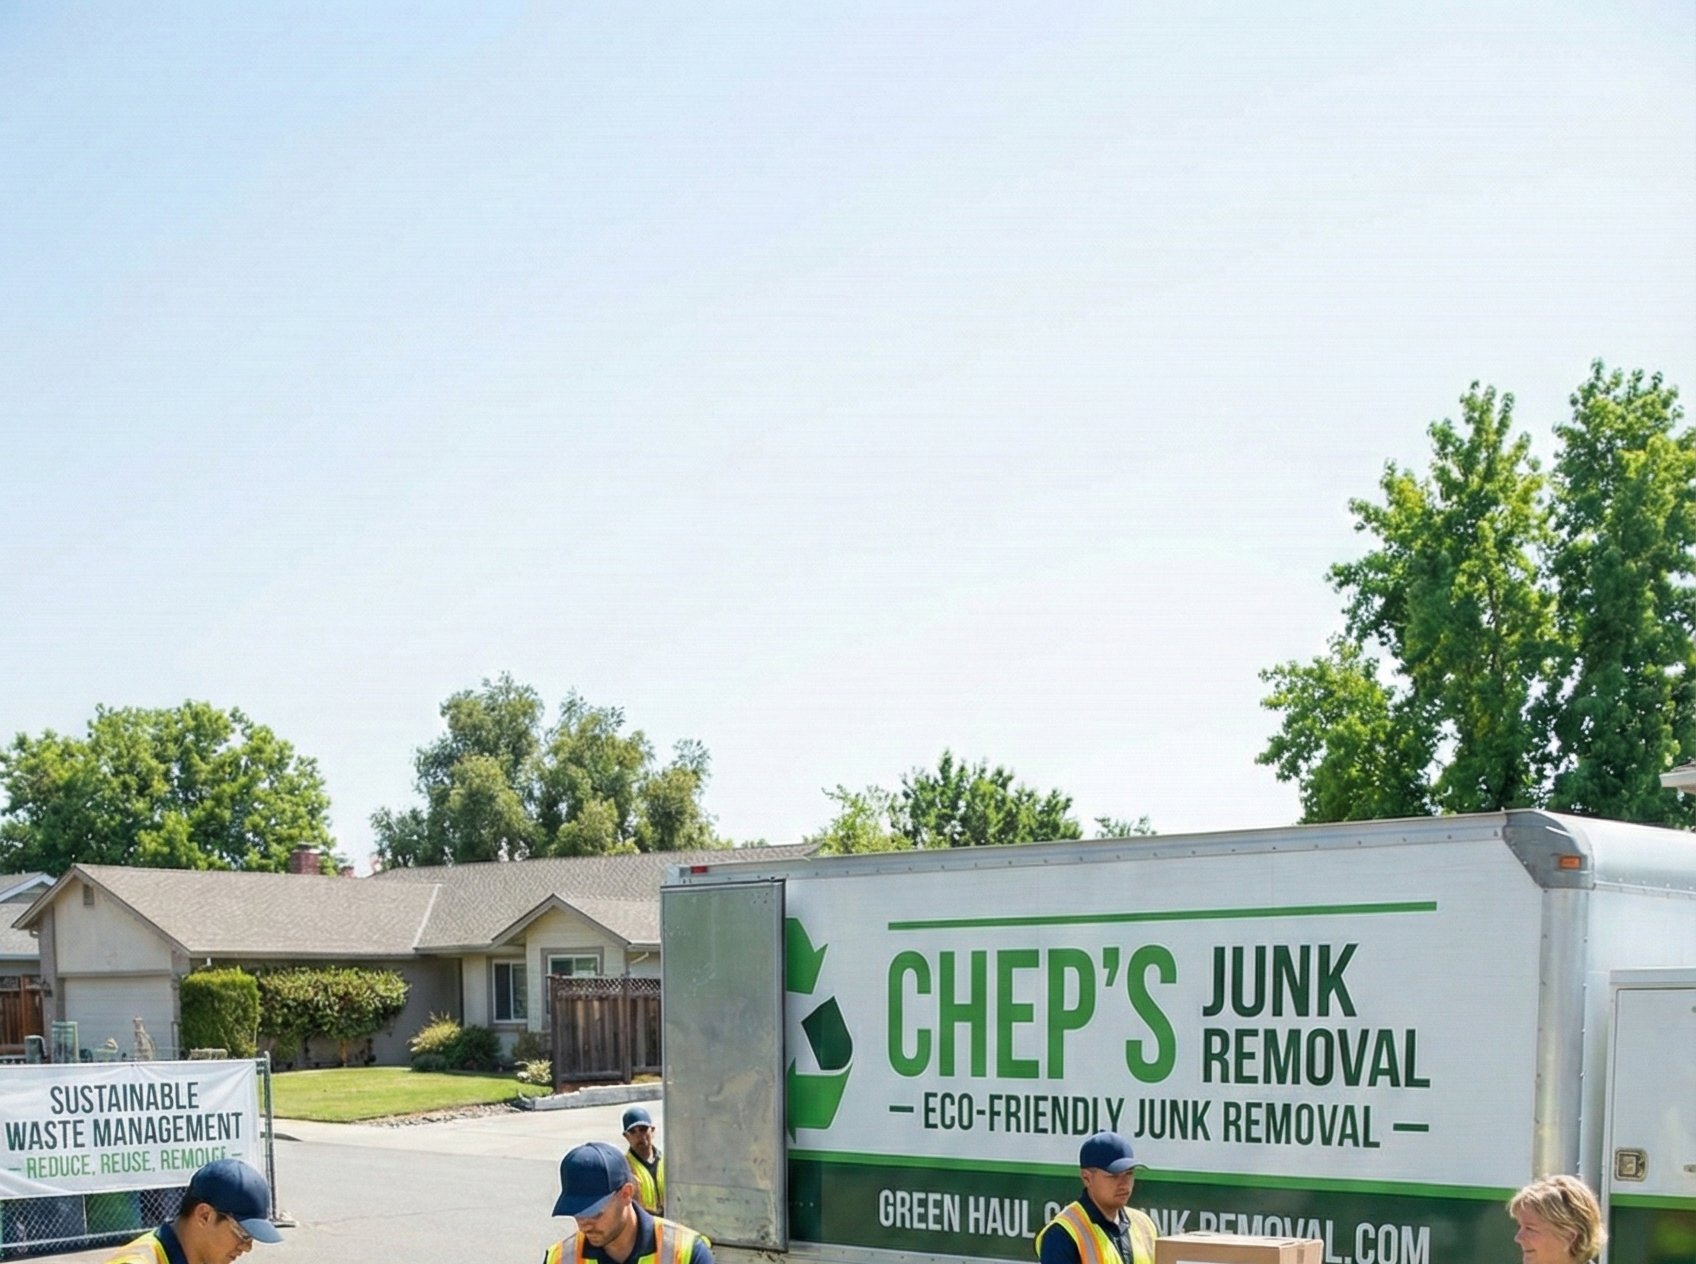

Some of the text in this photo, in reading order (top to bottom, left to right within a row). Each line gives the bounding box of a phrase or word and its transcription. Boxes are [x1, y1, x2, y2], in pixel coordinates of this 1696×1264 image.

[1202, 943, 1359, 1018] JUNK
[887, 944, 1178, 1084] CHEP'S
[1202, 1027, 1431, 1088] REMOVAL
[50, 1081, 200, 1115] SUSTAINABLE
[924, 1091, 1381, 1149] ECO-FRIENDLY JUNK REMOVAL
[5, 1111, 243, 1152] WASTE MANAGEMENT
[26, 1154, 96, 1179] REDUCE,
[100, 1150, 156, 1174] REUSE,
[878, 1188, 961, 1233] GREEN
[968, 1195, 1036, 1239] HAUL
